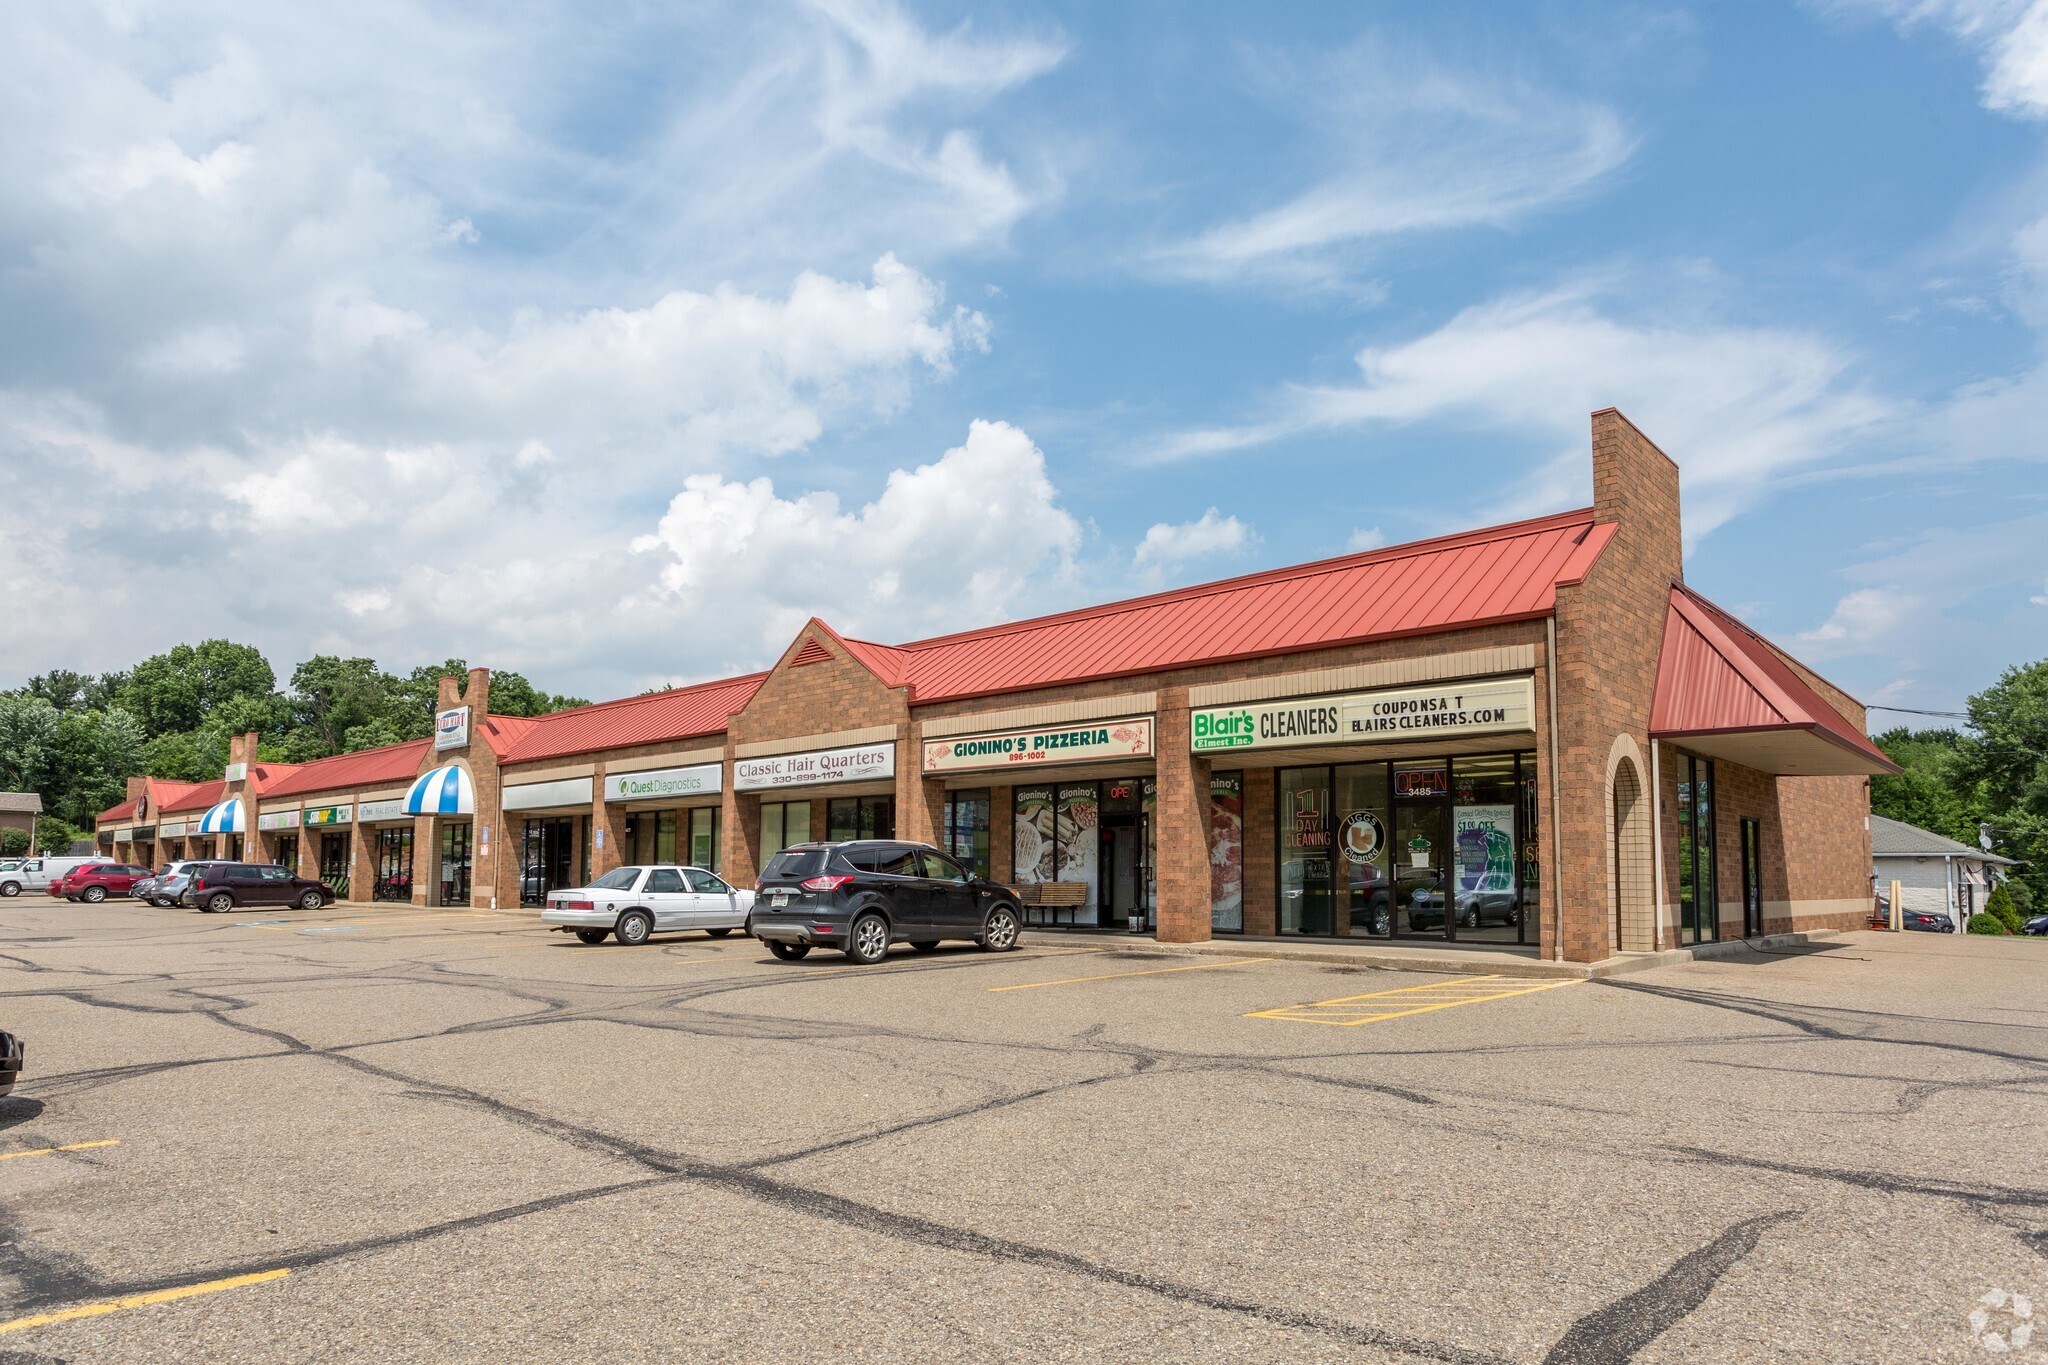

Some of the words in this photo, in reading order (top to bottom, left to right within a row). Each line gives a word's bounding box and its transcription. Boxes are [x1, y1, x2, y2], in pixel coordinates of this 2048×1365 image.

[1194, 710, 1255, 737] Blair's
[1260, 706, 1338, 739] CLEANERS
[954, 738, 1027, 757] GIONINO'S
[1034, 729, 1109, 750] PIZZERIA
[1197, 739, 1229, 748] Elmest
[1233, 736, 1251, 746] Inc.
[1009, 751, 1046, 762] 896-1002
[739, 762, 782, 777] Classic
[787, 757, 815, 772] Hair
[820, 751, 885, 769] Quarters
[772, 770, 844, 784] 330-899-1174
[1211, 778, 1239, 790] nino's
[1397, 771, 1448, 792] OPEN
[630, 780, 654, 794] Quest
[654, 777, 701, 793] Diagnostics
[1111, 786, 1135, 799] OPE
[1408, 787, 1432, 797] 3485
[1018, 789, 1053, 802] Gionino's
[1060, 787, 1097, 800] Gionino's
[1297, 788, 1319, 818] 1
[1296, 819, 1318, 832] DAY
[1347, 813, 1378, 827] UGGS
[1478, 820, 1496, 833] OFF
[1284, 832, 1332, 848] CLEANING
[1344, 846, 1380, 863] Cleaned
